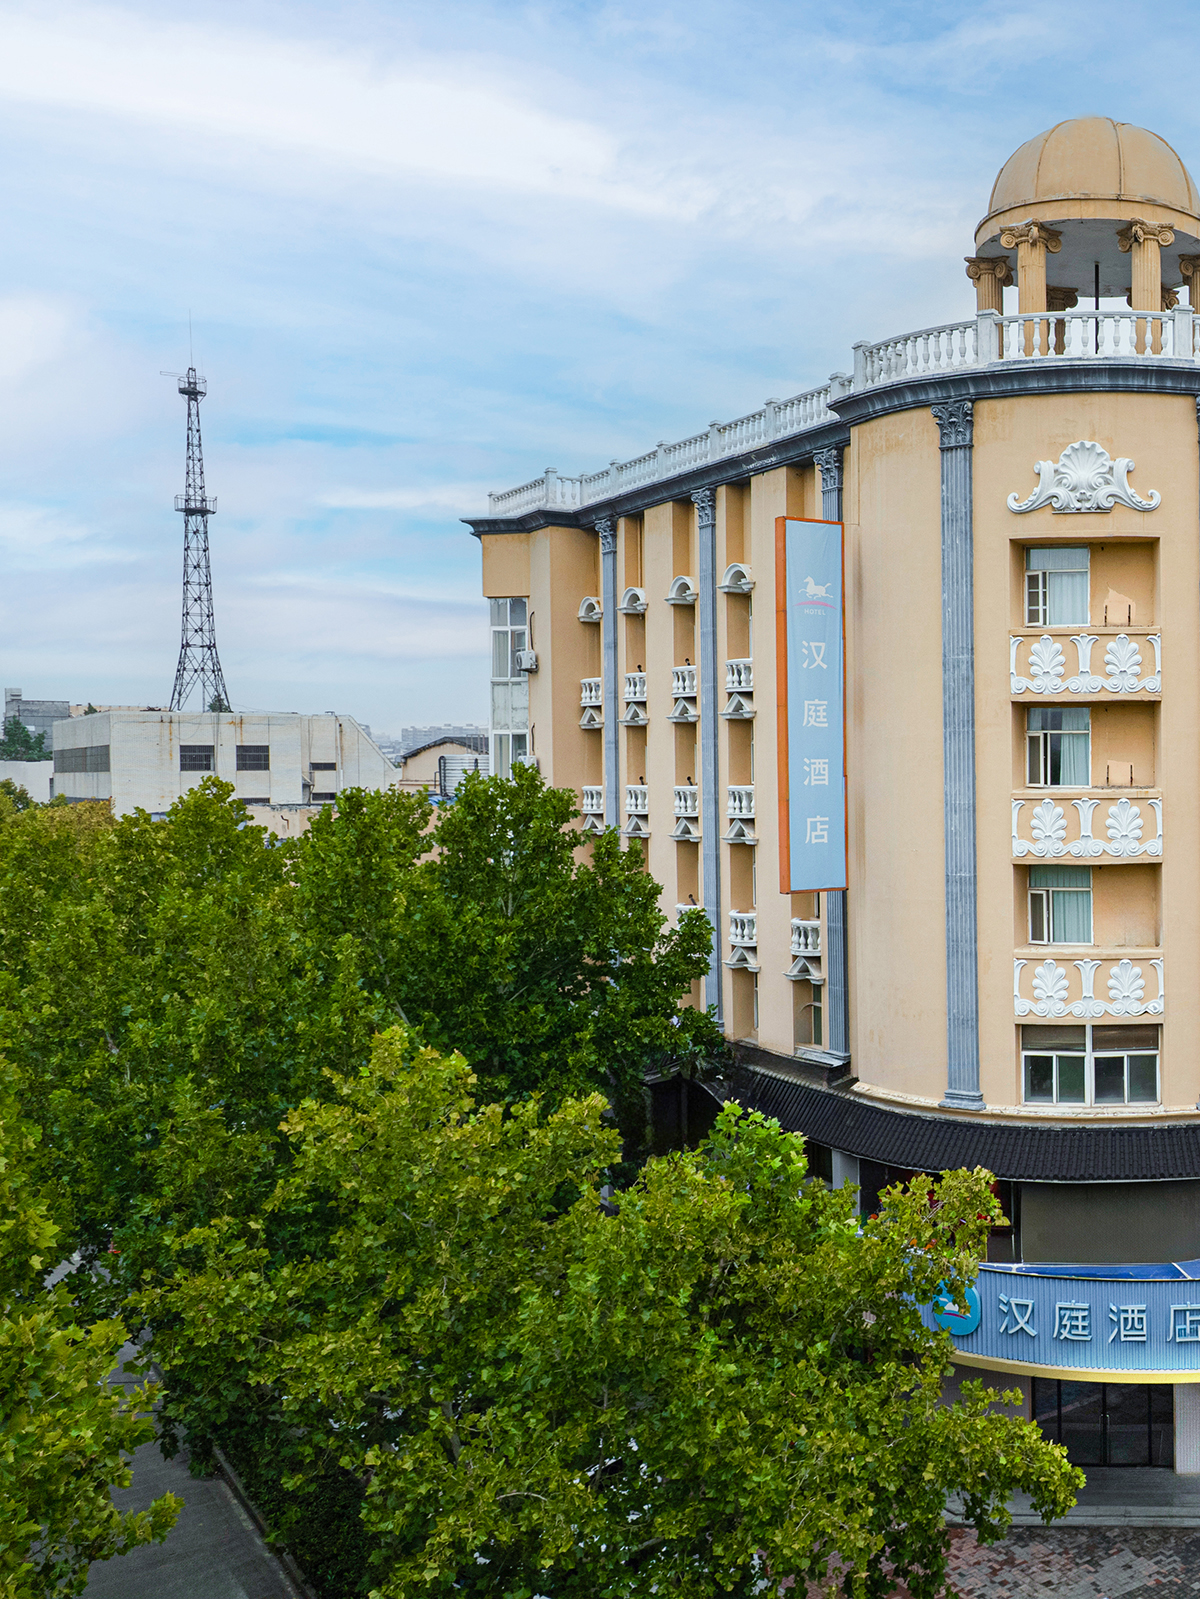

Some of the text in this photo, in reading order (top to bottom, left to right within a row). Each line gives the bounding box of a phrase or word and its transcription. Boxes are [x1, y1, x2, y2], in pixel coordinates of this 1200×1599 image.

[804, 608, 826, 616] HOTEL
[802, 640, 829, 844] 汉庭酒店
